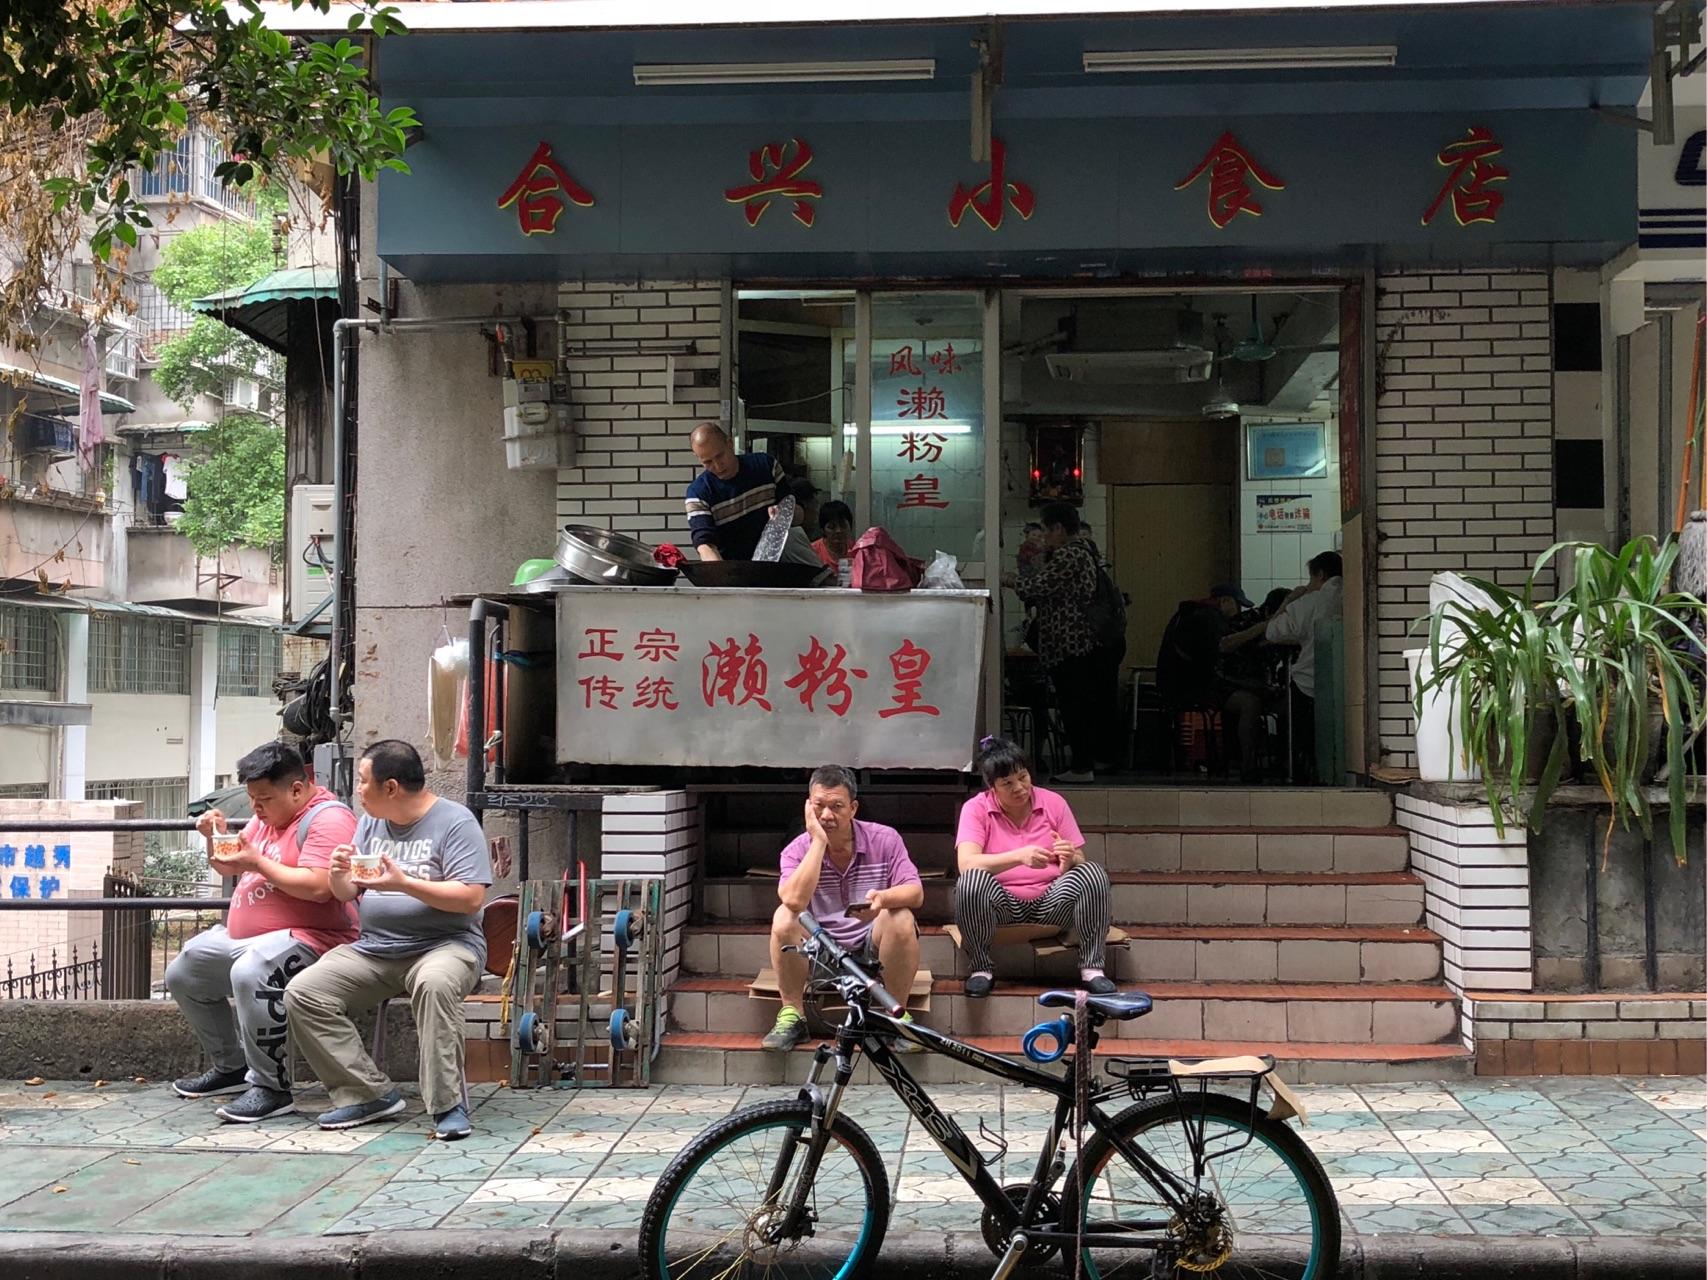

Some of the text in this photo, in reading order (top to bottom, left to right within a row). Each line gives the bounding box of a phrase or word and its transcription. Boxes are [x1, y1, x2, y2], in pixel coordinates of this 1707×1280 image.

[498, 128, 1510, 235] 合兴小食店
[889, 342, 962, 376] 风味
[896, 386, 950, 510] 濑粉皇
[578, 628, 680, 662] 正宗
[578, 675, 680, 711] 传统
[0, 876, 61, 899] 保护
